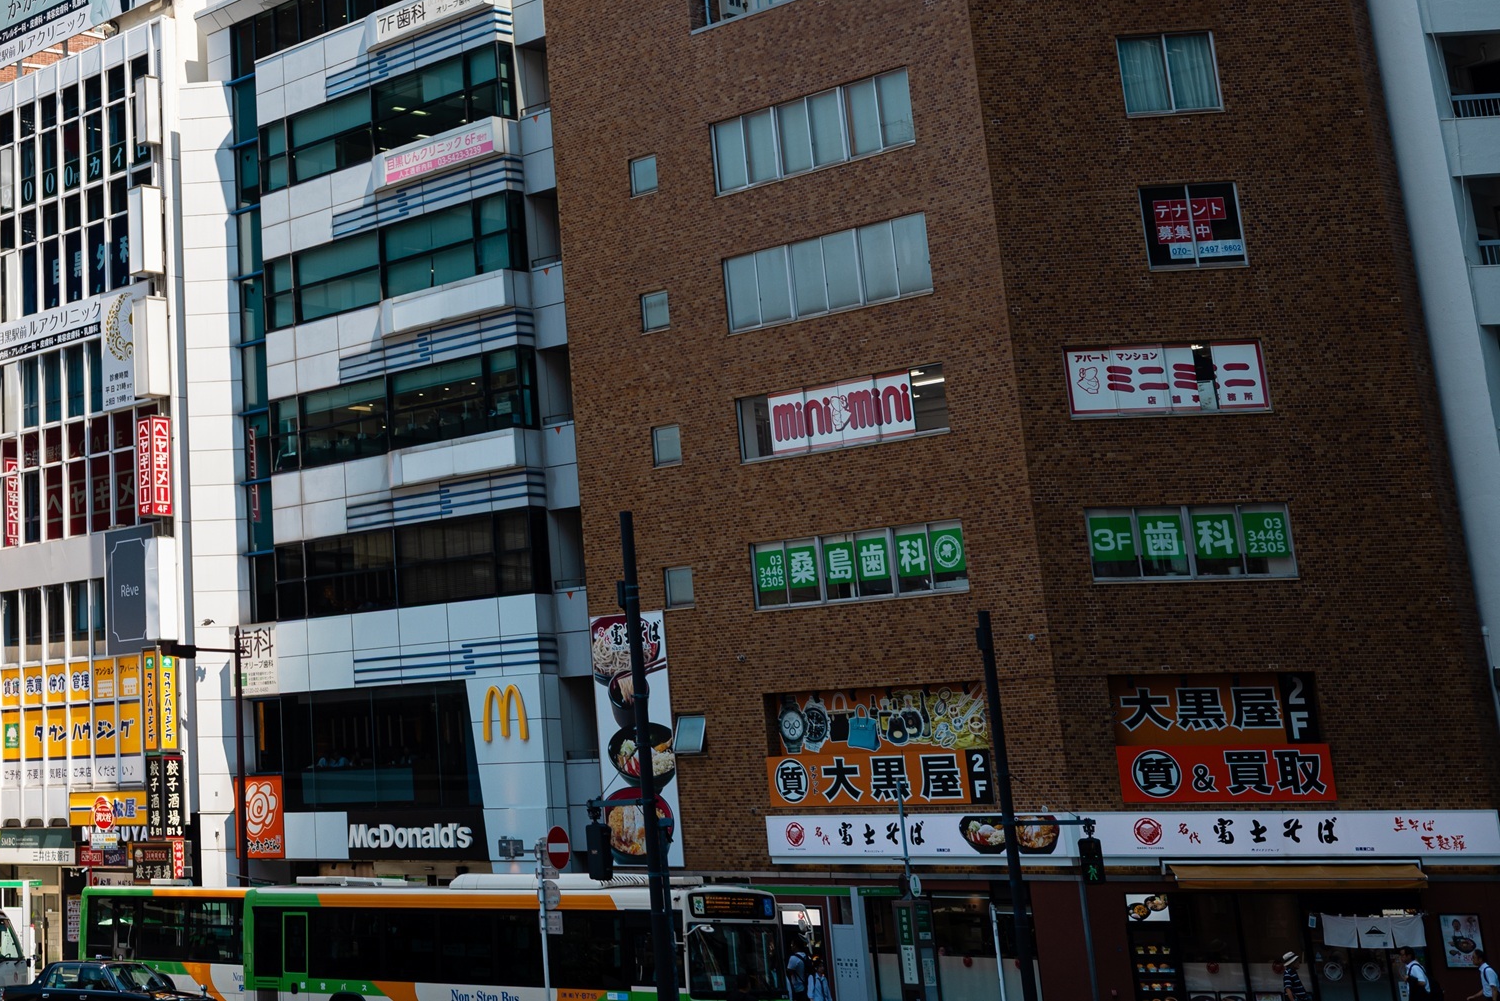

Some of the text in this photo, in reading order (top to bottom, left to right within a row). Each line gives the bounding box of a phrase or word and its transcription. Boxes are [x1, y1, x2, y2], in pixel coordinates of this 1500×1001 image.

[16, 11, 86, 56] ルアクリニック
[387, 137, 462, 171] 目黒じんクリニック
[464, 132, 476, 146] 6F
[1155, 201, 1223, 219] テナント
[1157, 224, 1211, 241] 募集中
[28, 301, 101, 337] ルアクリニック
[1074, 351, 1158, 363] アパート マンション
[141, 505, 150, 513] 4F
[157, 504, 169, 513] 4F
[1263, 518, 1282, 529] 03
[1093, 519, 1234, 556] 3F 歯科
[1248, 530, 1284, 542] 3446
[1250, 541, 1286, 553] 2305
[770, 554, 782, 566] 03
[791, 538, 927, 584] 桑島歯科
[759, 565, 783, 577] 3446
[120, 584, 139, 598] Rêve
[761, 576, 785, 588] 2305
[95, 663, 139, 676] マンション アパート
[4, 673, 90, 694] 賃貸 売買 仲介 管理
[146, 672, 155, 742] タウンハウジング
[163, 671, 173, 742] タウンハウジング
[1119, 686, 1284, 731] 大黒屋
[821, 753, 965, 803] 大黒屋
[150, 761, 160, 826] 餃子酒場
[166, 760, 181, 826] 餃子酒場
[112, 798, 136, 818] 松屋
[166, 827, 176, 836] B1
[348, 823, 473, 849] McDonald's
[838, 820, 925, 846] 富士そば
[1213, 817, 1339, 844] 富士そば
[1, 837, 16, 846] SMBC
[32, 850, 70, 862] 三井住友銀行
